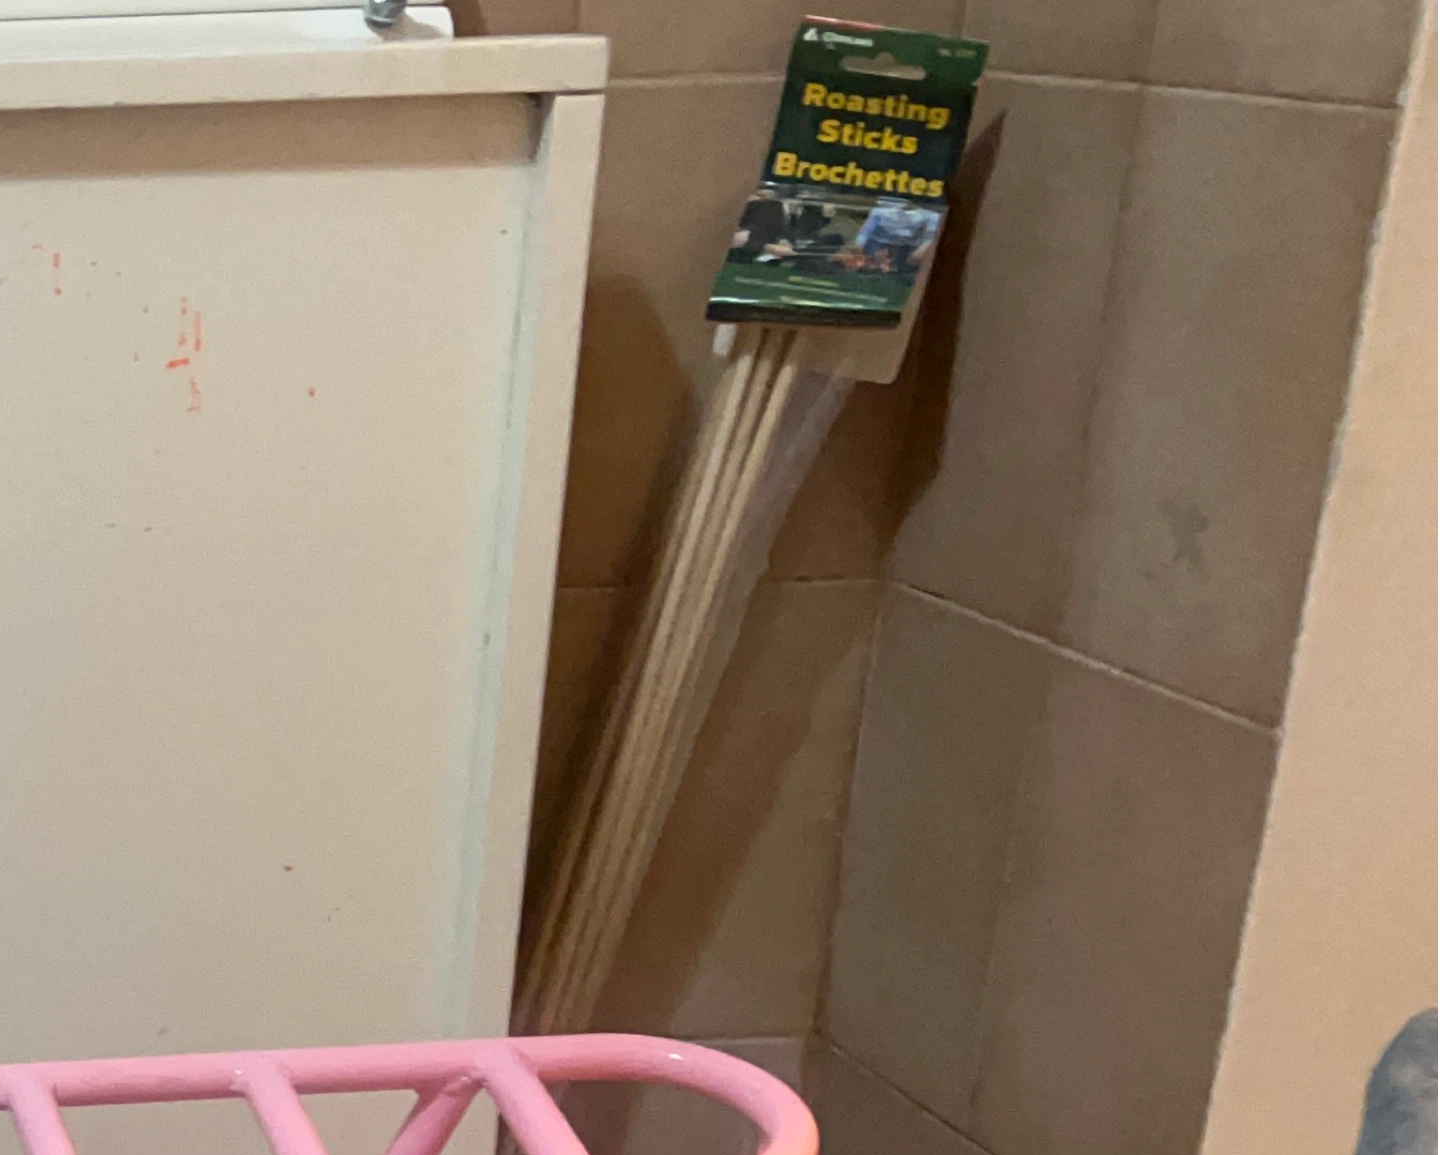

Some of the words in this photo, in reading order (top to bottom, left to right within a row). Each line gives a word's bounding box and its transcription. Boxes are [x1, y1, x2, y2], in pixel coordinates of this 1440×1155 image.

[803, 83, 950, 130] Roasting
[817, 119, 918, 154] Sticks
[773, 152, 944, 197] Brochettes
